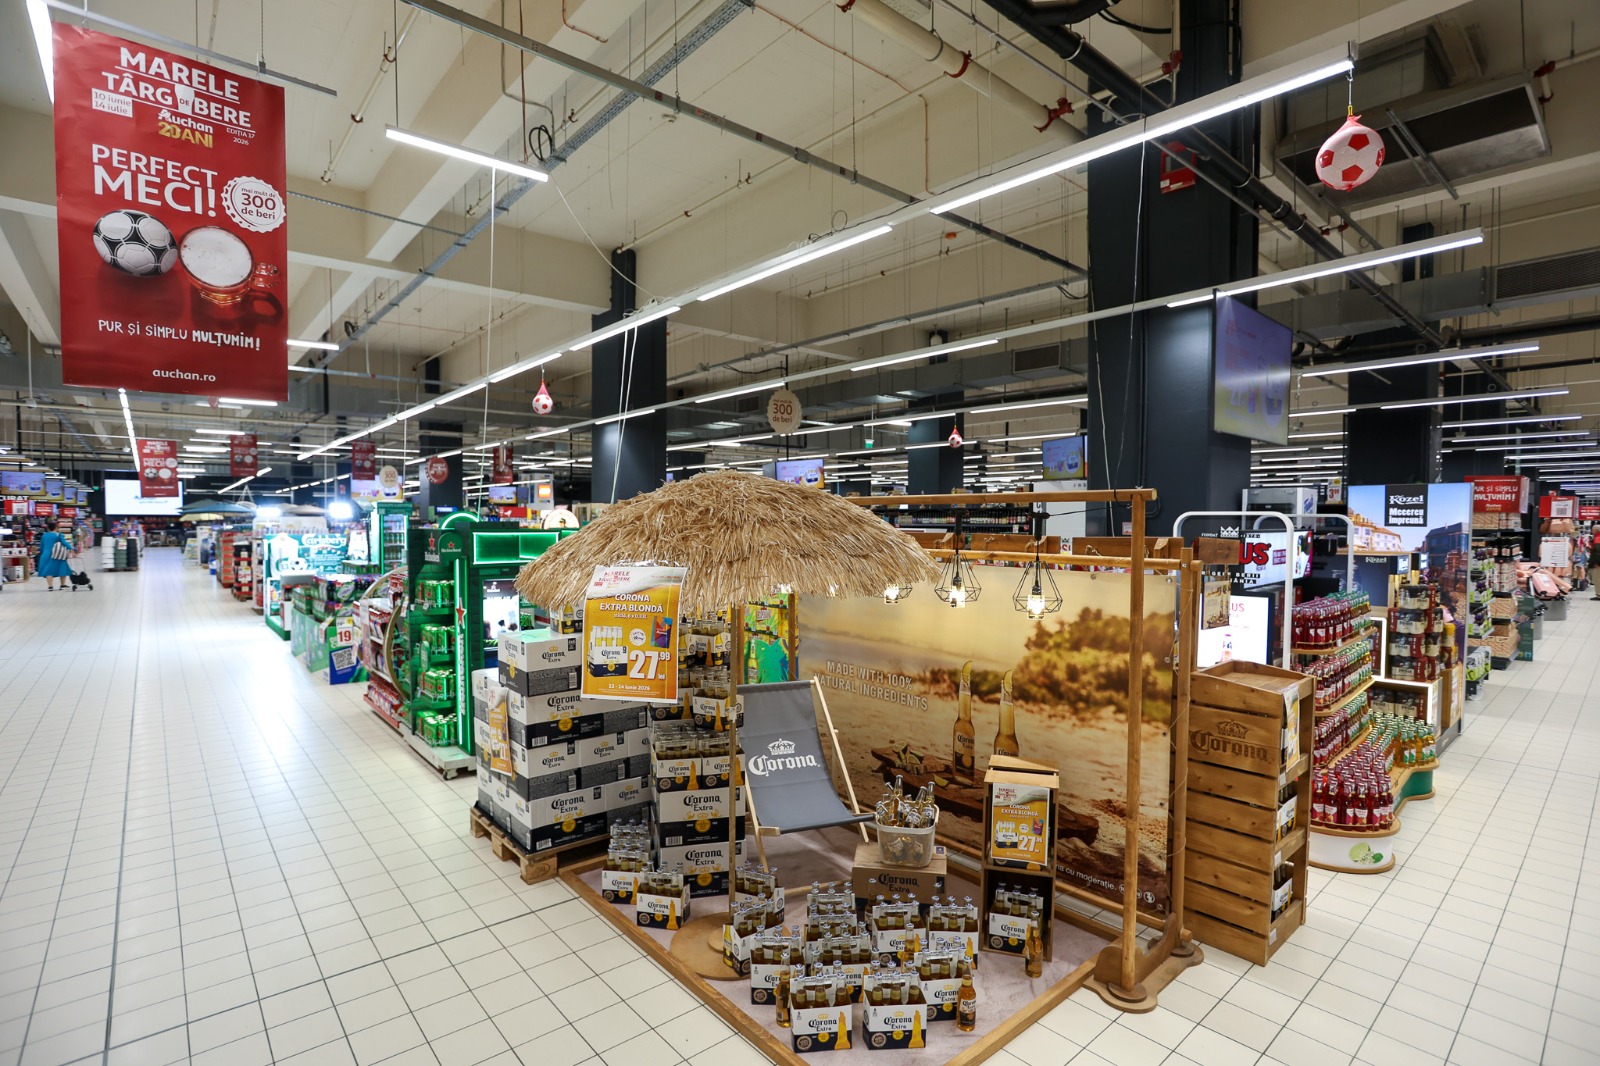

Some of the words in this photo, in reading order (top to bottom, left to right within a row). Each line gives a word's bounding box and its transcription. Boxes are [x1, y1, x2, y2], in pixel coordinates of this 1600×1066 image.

[121, 47, 239, 100] MARELE
[94, 92, 106, 100] 10
[108, 94, 131, 106] iunie
[102, 72, 173, 105] TÂRG
[180, 98, 190, 106] DE
[194, 100, 251, 128] BERE
[94, 100, 106, 109] 14
[108, 103, 128, 114] iulie
[158, 109, 213, 134] Auchan
[233, 137, 249, 145] 2026
[92, 144, 217, 188] PERFECT
[94, 164, 216, 218] MECI!
[242, 193, 276, 210] 300
[241, 207, 254, 216] de
[256, 209, 275, 220] beri
[98, 319, 124, 334] PUR
[152, 368, 216, 382] auchan.ro
[773, 403, 792, 415] 300
[1389, 495, 1424, 505] Kozel
[1389, 516, 1424, 525] împreună
[614, 594, 650, 602] CORONA
[600, 603, 627, 611] EXTRA
[629, 604, 663, 613] BLONDĂ
[338, 631, 351, 642] 19
[542, 651, 566, 660] Corona
[630, 650, 659, 680] 27
[827, 660, 854, 677] MADE
[858, 666, 884, 683] WITH
[887, 673, 912, 690] 100%
[547, 695, 582, 707] Corona
[860, 683, 928, 710] INGREDIENTS
[594, 745, 615, 754] Corona
[1190, 730, 1268, 760] Corona
[542, 755, 565, 765] Corona
[748, 754, 818, 777] Corona
[619, 789, 639, 798] Corona
[683, 794, 721, 806] Corona
[551, 796, 585, 810] Corona
[560, 805, 578, 813] Extra
[1019, 835, 1036, 851] 27
[685, 850, 723, 861] Corona
[878, 873, 919, 886] Corona
[1076, 871, 1116, 891] moderație.
[648, 902, 669, 910] Corona
[1001, 924, 1025, 933] Corona
[808, 1019, 837, 1027] Corona
[884, 1017, 912, 1025] Corona
